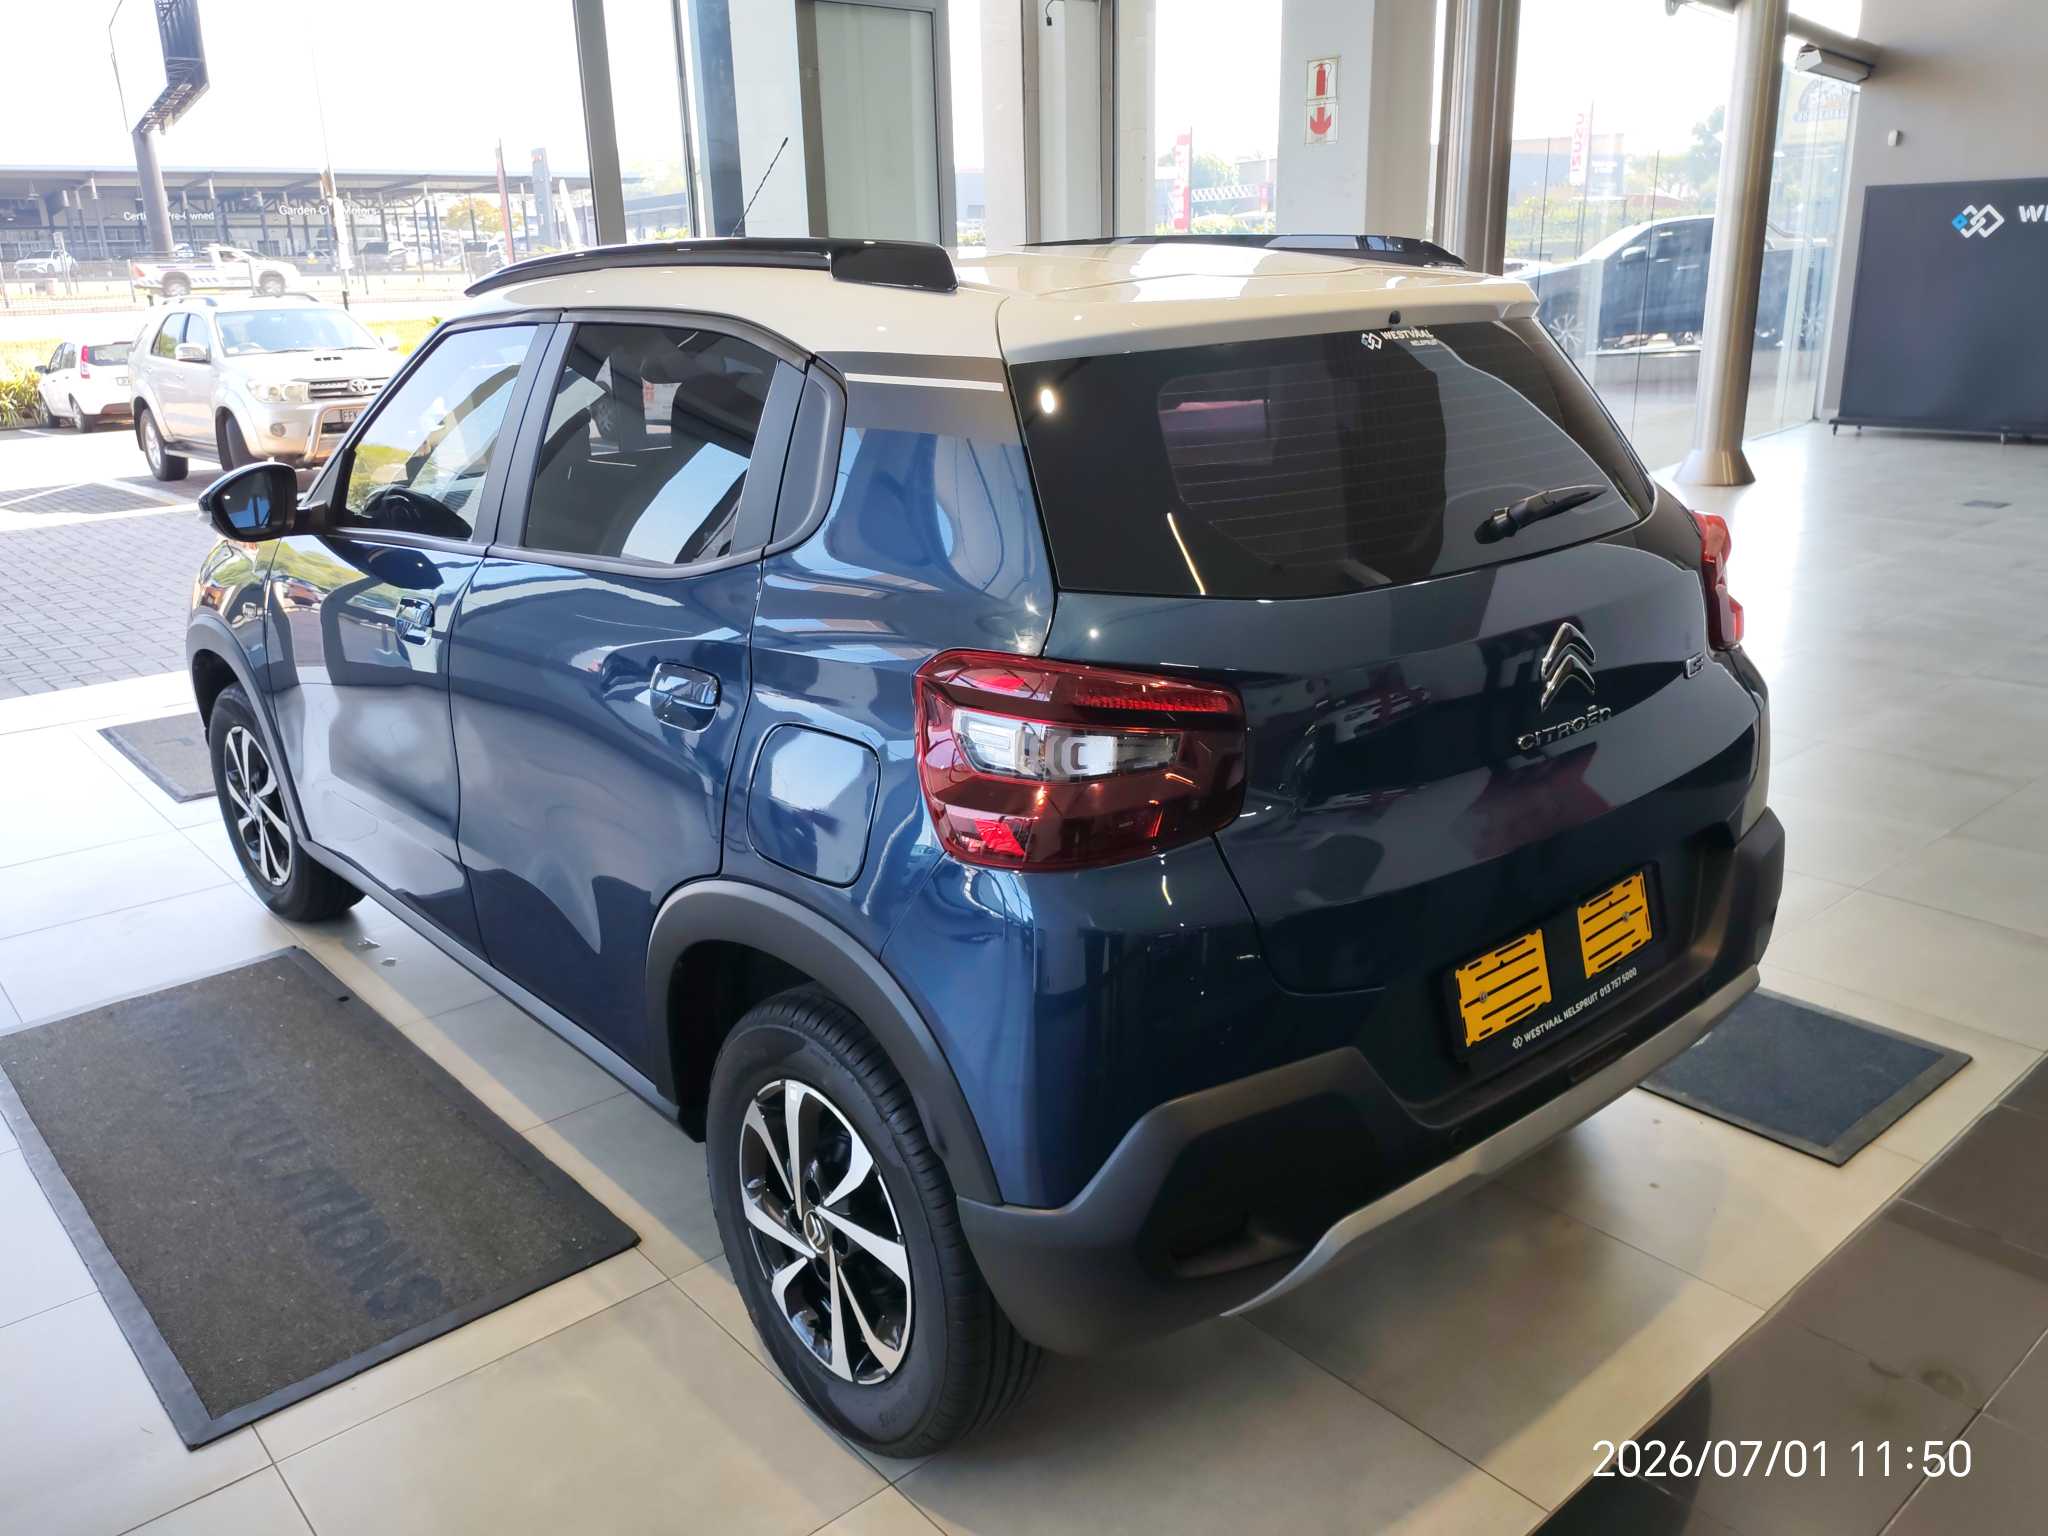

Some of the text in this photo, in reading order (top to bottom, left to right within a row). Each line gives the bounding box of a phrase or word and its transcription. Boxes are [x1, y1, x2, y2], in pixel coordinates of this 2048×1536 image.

[279, 205, 317, 216] Garden
[2018, 204, 2048, 223] W
[1380, 329, 1434, 340] WESTVAAL
[1523, 1015, 1563, 1042] WESTVAAL
[1563, 991, 1599, 1020] NELSPRUIT
[1599, 983, 1611, 998] 013
[1622, 967, 1637, 982] 5000
